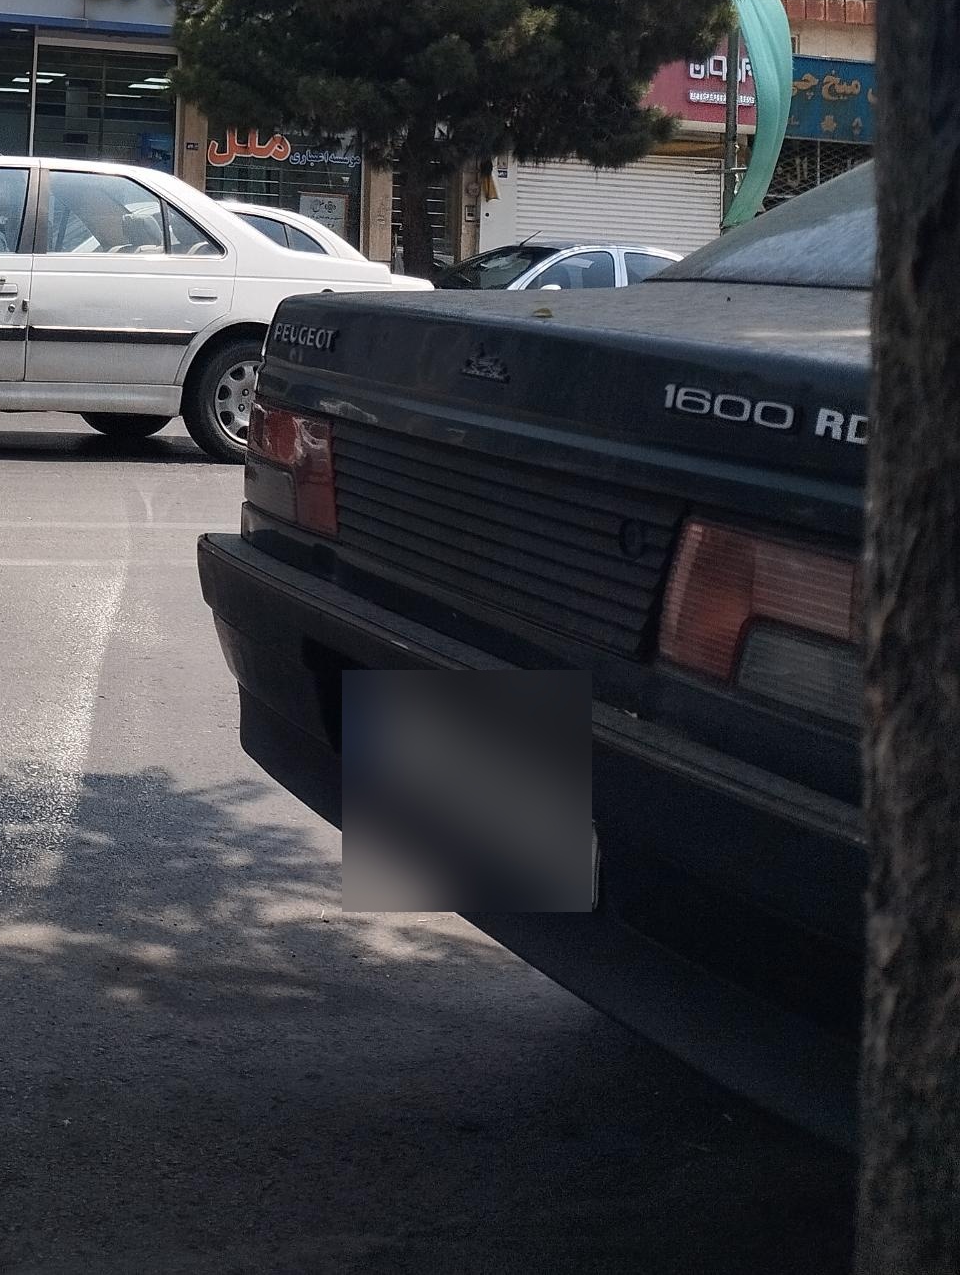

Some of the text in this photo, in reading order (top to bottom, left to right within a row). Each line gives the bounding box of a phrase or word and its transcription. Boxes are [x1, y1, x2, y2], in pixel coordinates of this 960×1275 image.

[208, 126, 291, 166] ملل
[273, 322, 335, 349] PEUGEOT
[664, 383, 795, 430] 1600
